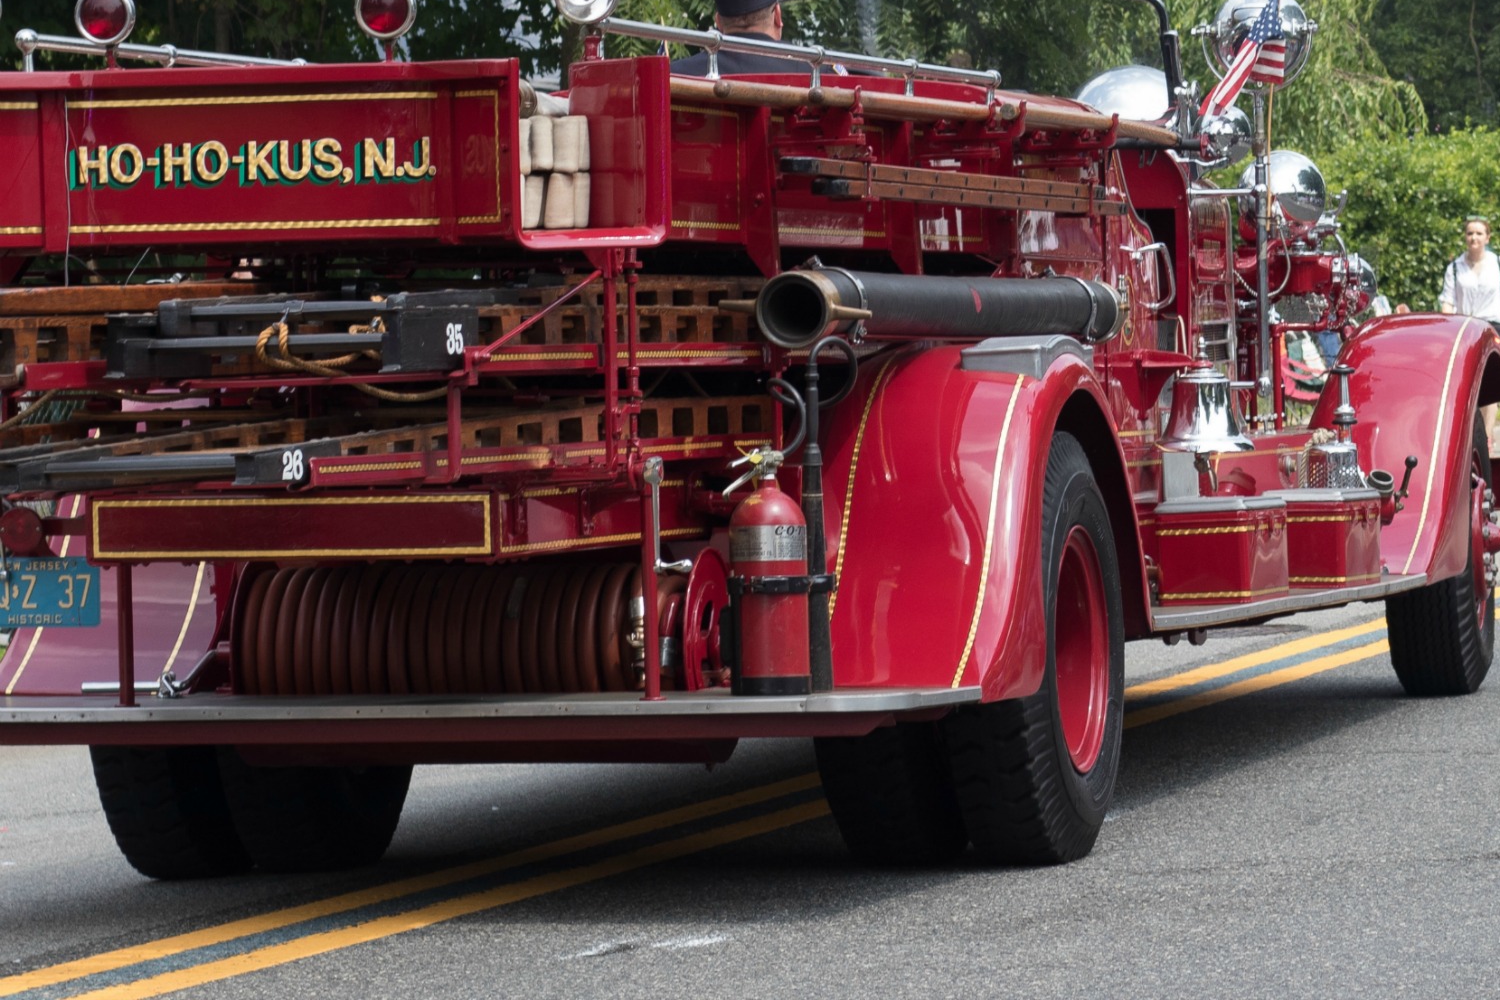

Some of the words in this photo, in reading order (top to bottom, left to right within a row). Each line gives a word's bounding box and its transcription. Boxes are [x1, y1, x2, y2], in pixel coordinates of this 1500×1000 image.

[73, 138, 353, 189] HO-HO-KUS,
[356, 136, 438, 186] N.J.
[446, 322, 464, 355] 35
[282, 448, 304, 481] 26
[26, 561, 69, 571] JERSEY
[8, 614, 63, 624] HISTORIC
